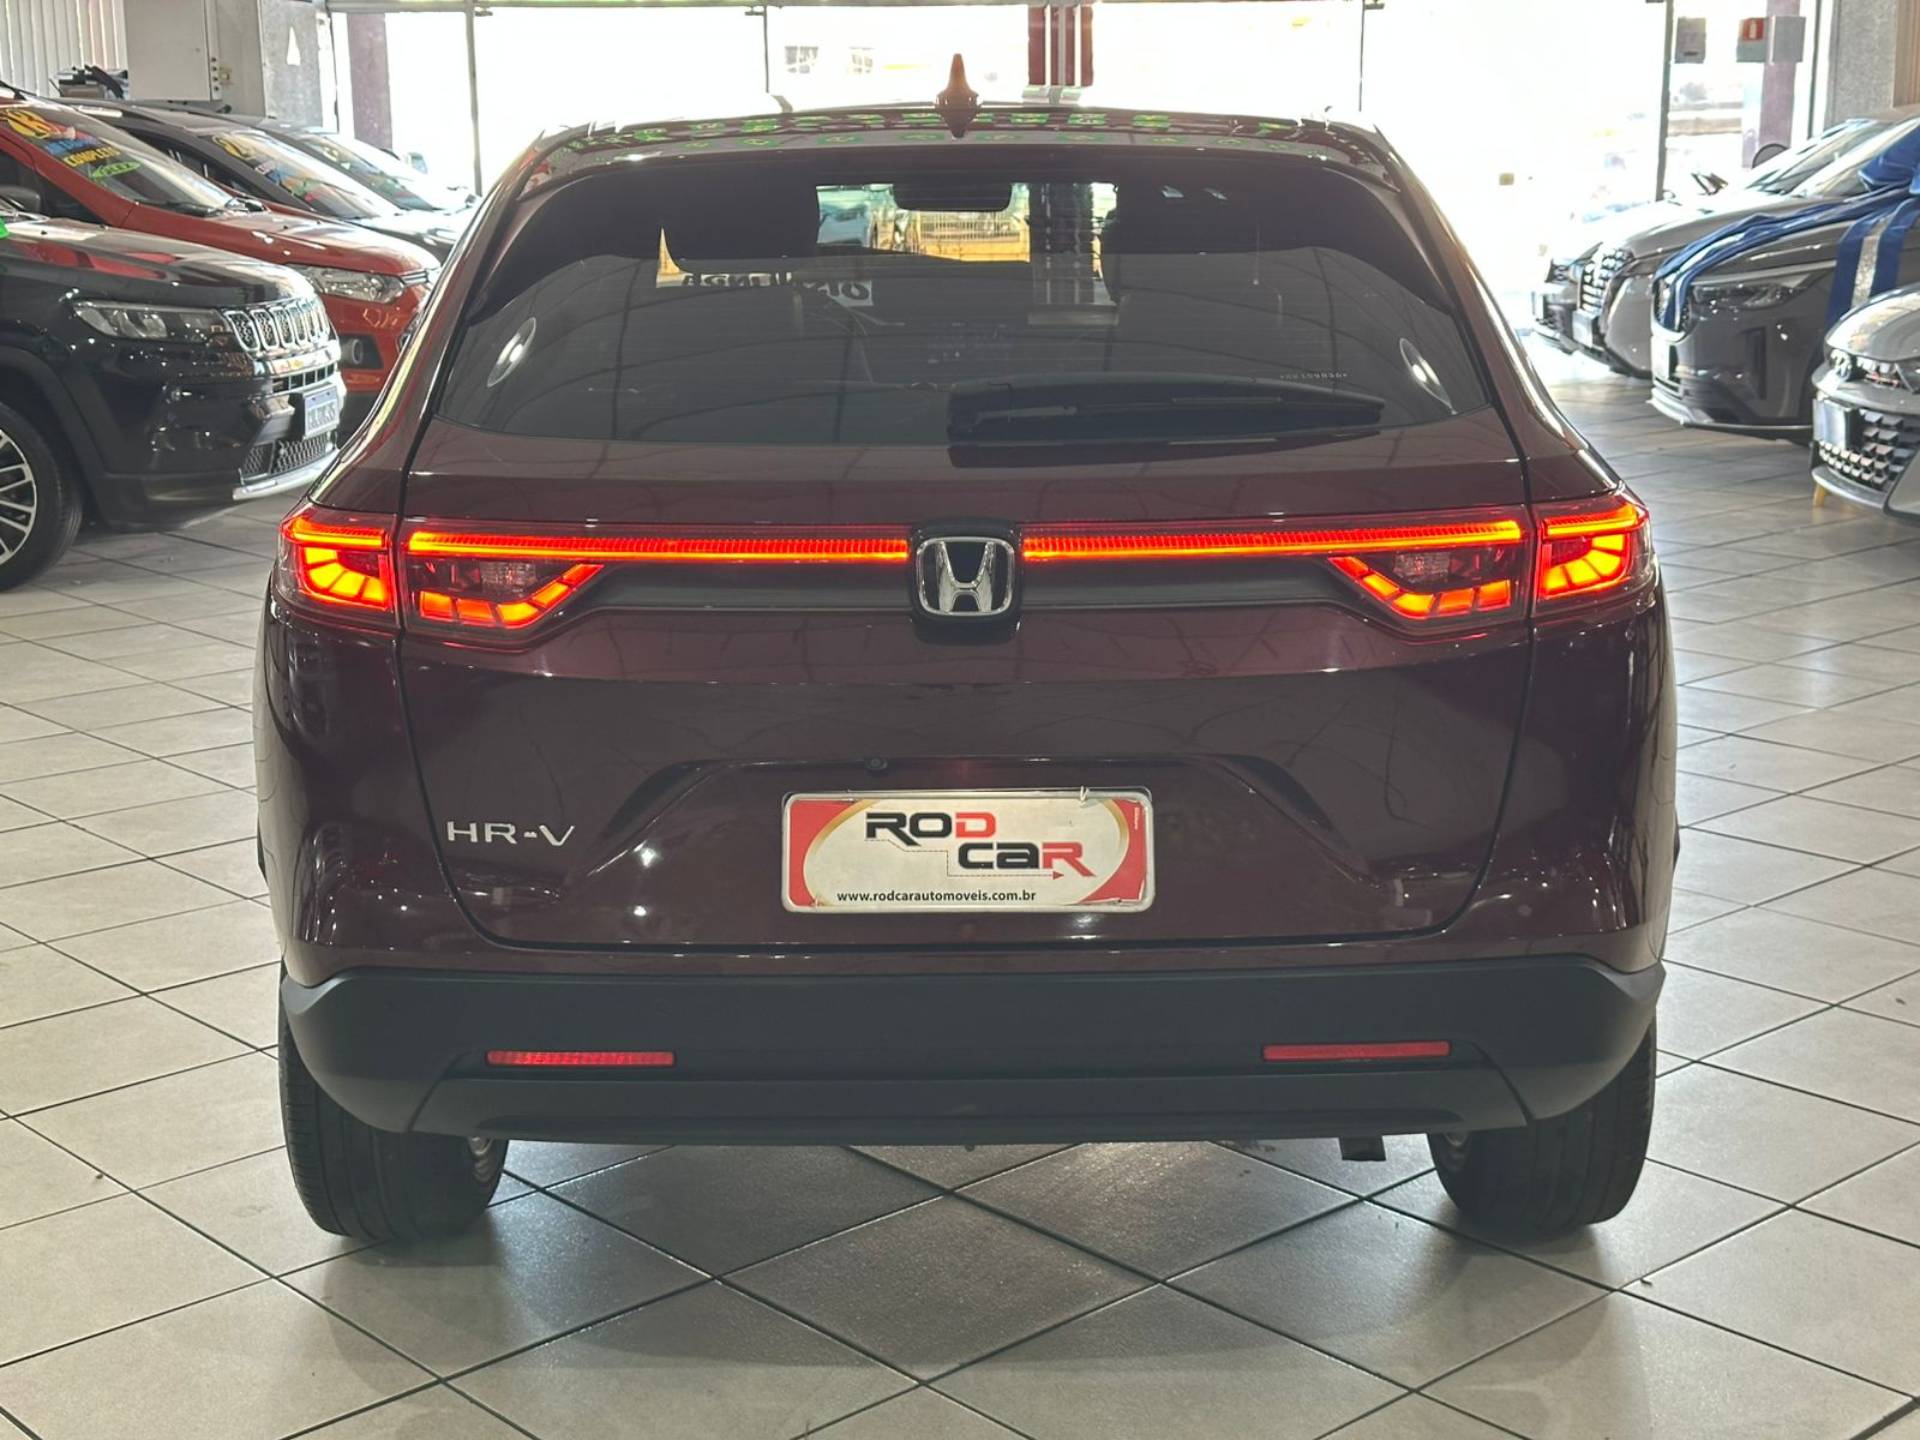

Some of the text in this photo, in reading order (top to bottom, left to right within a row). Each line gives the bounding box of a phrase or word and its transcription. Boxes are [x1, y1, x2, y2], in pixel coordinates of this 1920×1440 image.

[446, 820, 575, 847] HR-V
[865, 811, 996, 847] ROD
[836, 889, 1037, 902] www.rodcarautomoveis.com.br
